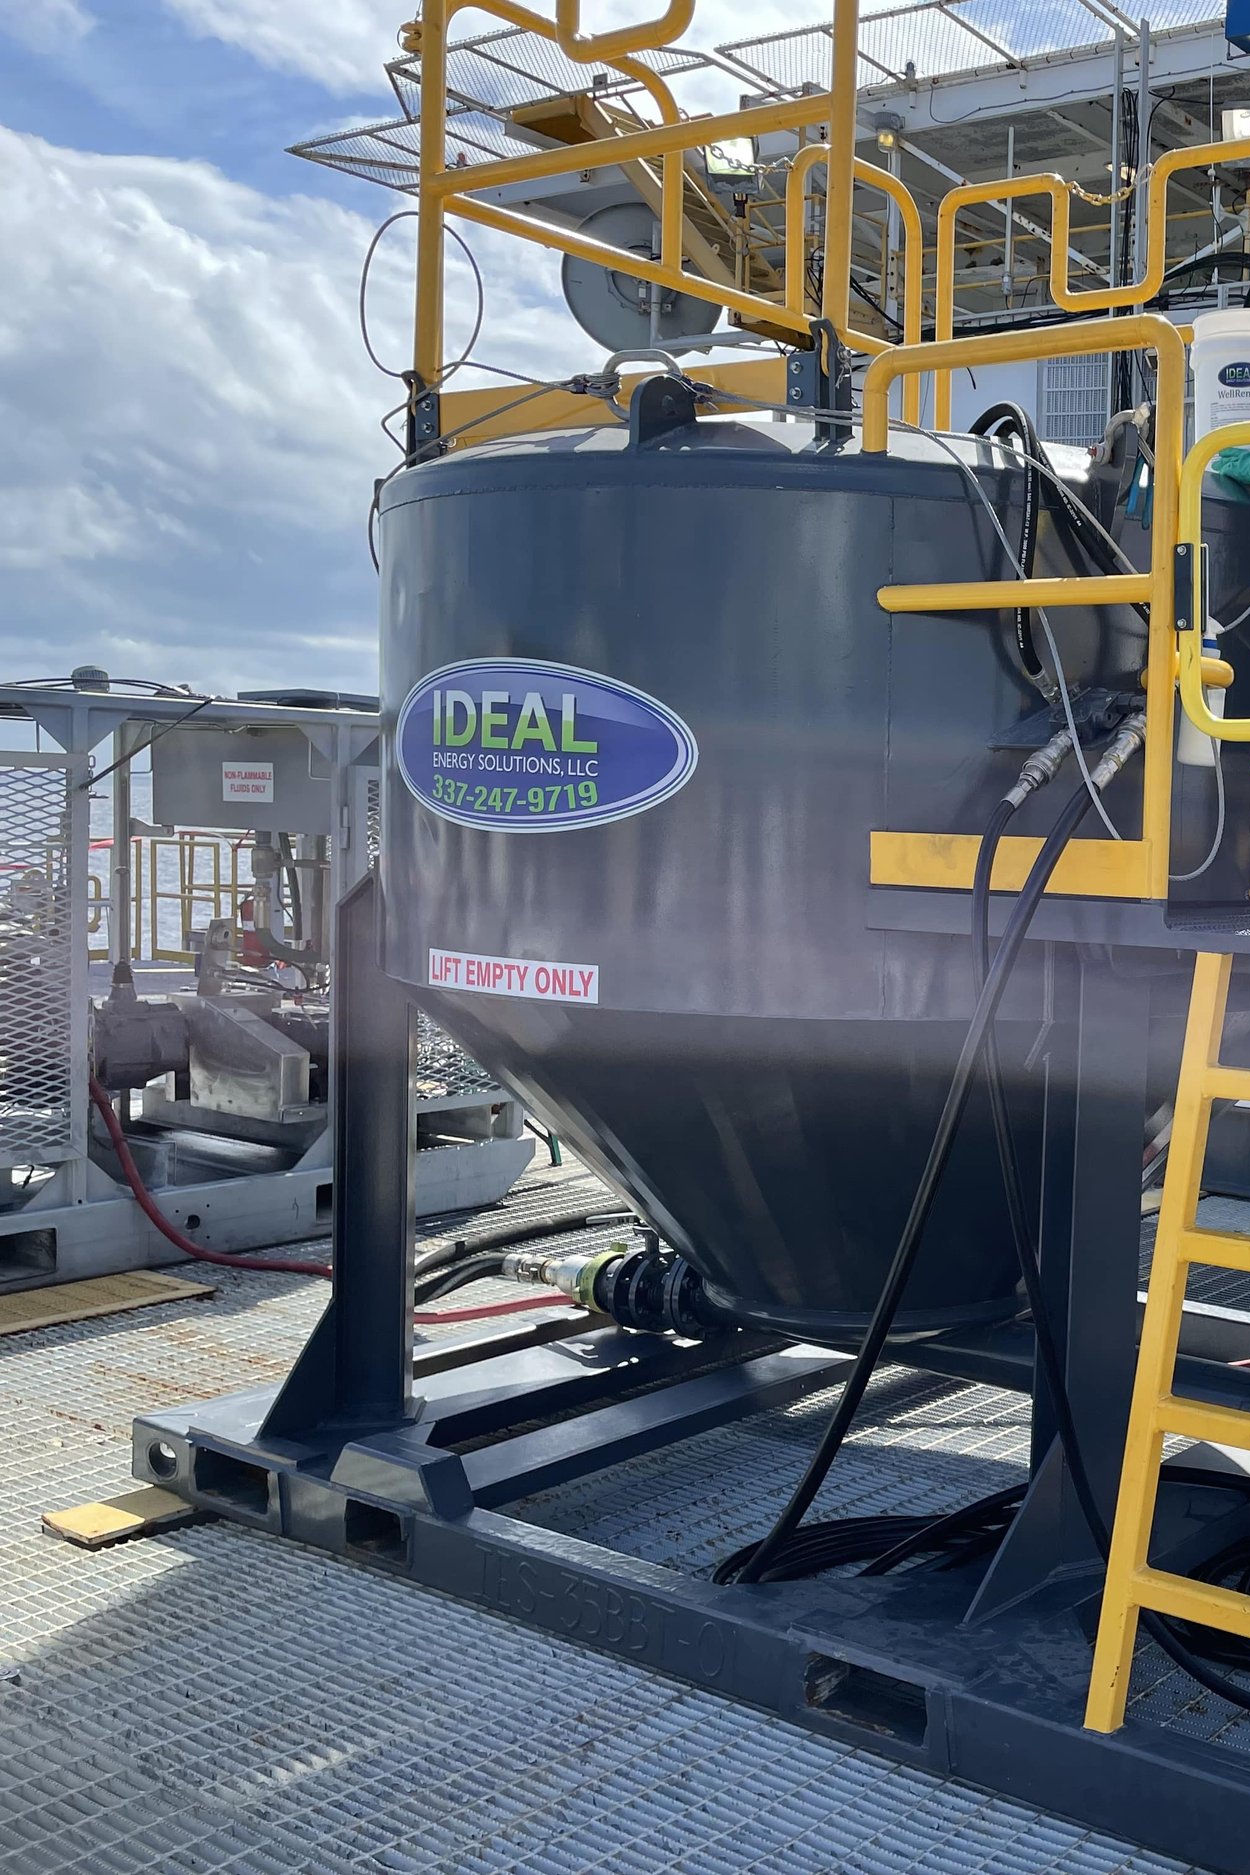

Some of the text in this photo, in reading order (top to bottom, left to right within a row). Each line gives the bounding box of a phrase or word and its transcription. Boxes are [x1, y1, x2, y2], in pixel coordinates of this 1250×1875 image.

[432, 689, 598, 753] IDEAL
[224, 771, 272, 781] NON-FLAMMABLE
[432, 752, 599, 778] ENERGY SOLUTIONS, LLC
[230, 783, 266, 793] FLUIDS ONLY
[432, 775, 599, 813] 337-247-9719
[431, 954, 594, 998] LIFT EMPTY ONLY
